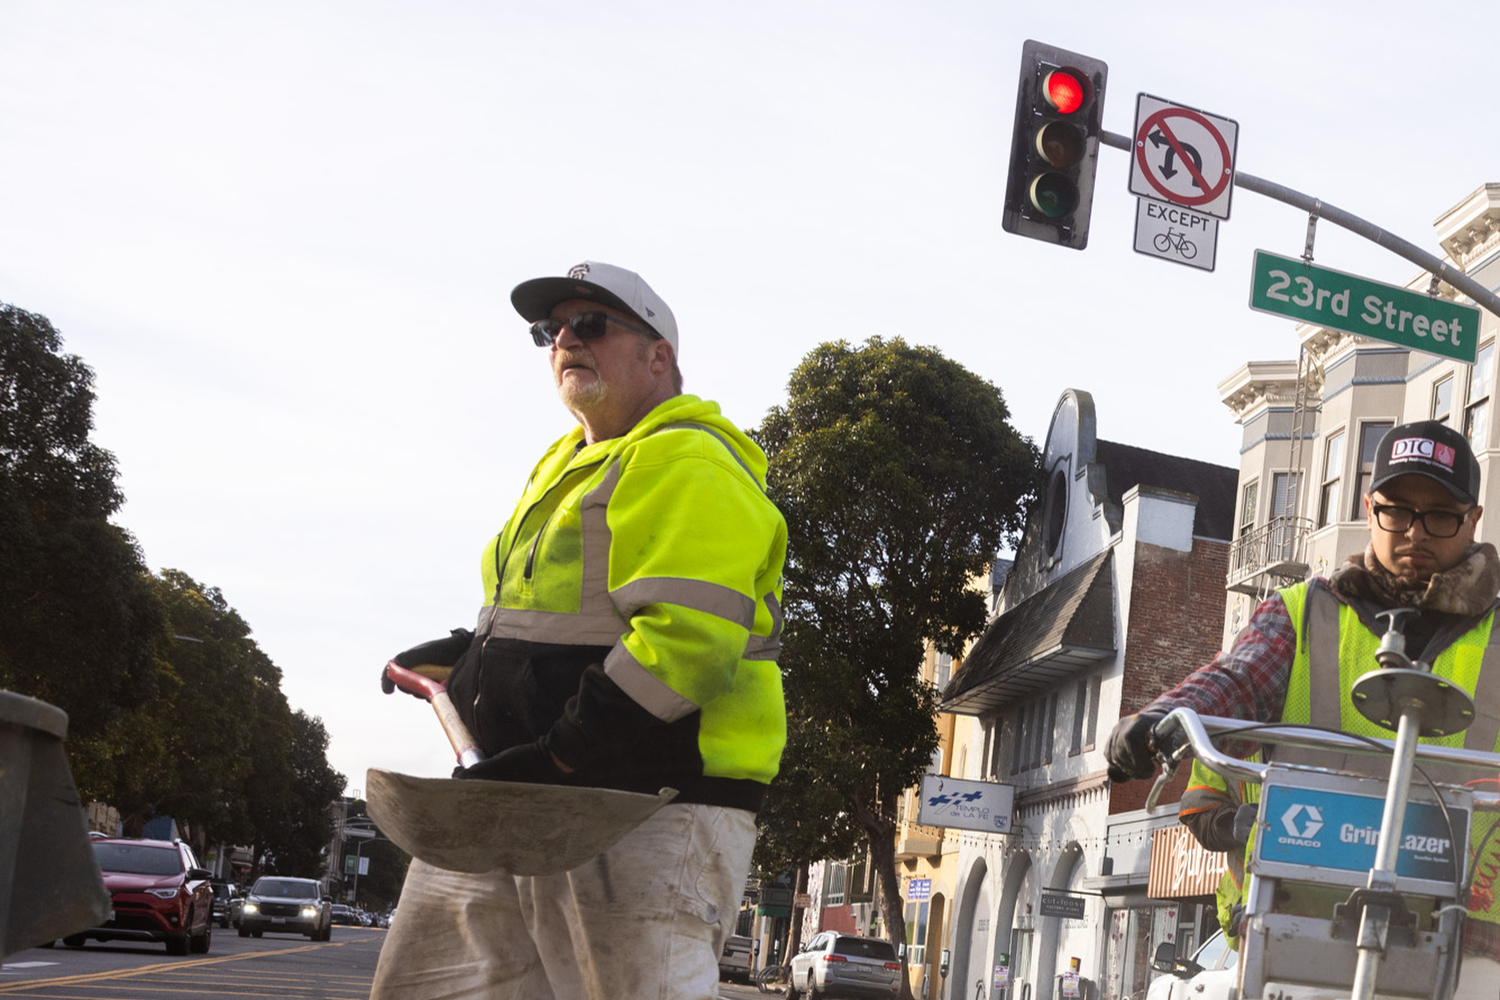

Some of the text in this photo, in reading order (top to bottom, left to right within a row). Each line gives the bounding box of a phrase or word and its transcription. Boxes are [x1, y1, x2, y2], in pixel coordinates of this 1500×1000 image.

[1147, 202, 1209, 232] EXCEPT
[1266, 269, 1463, 347] 23rd Street
[1394, 440, 1433, 456] DTC
[955, 805, 989, 815] TEMPLO
[1278, 836, 1321, 848] GRACO
